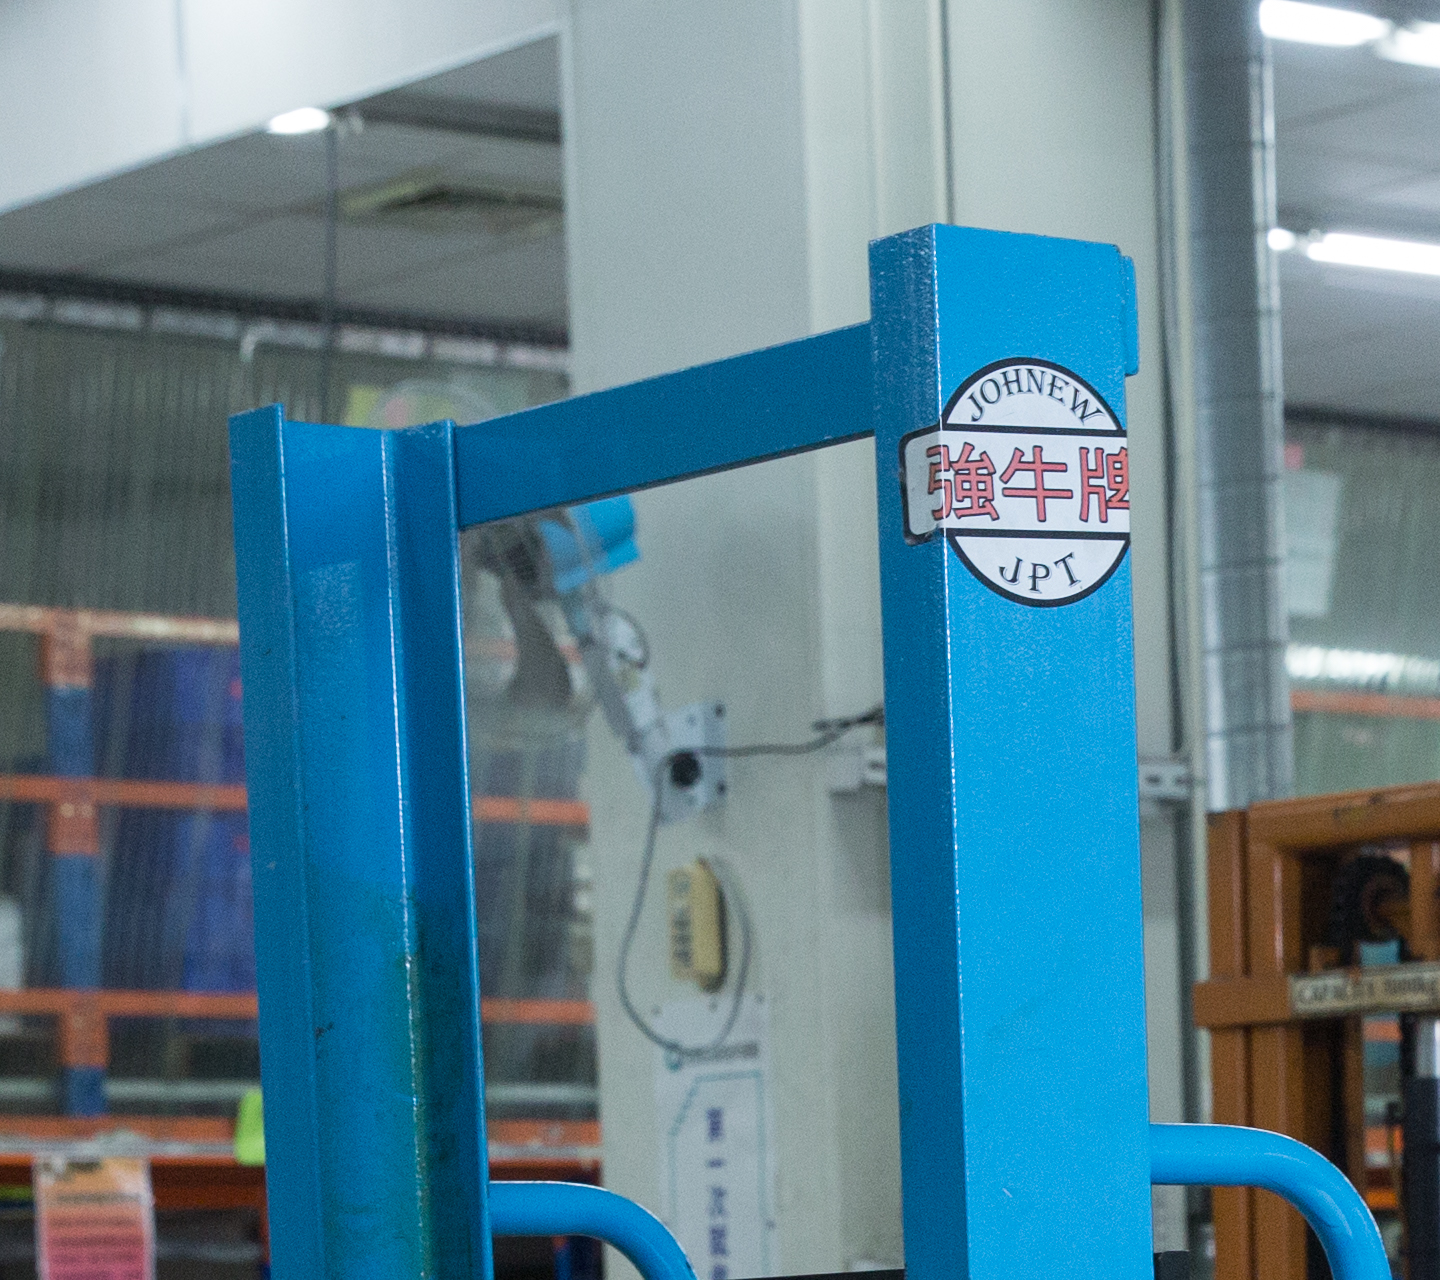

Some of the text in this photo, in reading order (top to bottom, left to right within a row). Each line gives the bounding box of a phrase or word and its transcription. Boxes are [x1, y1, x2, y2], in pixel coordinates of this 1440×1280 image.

[969, 368, 1104, 424] JOHNEW
[926, 441, 1130, 523] 強牛牌
[998, 552, 1081, 592] JPT
